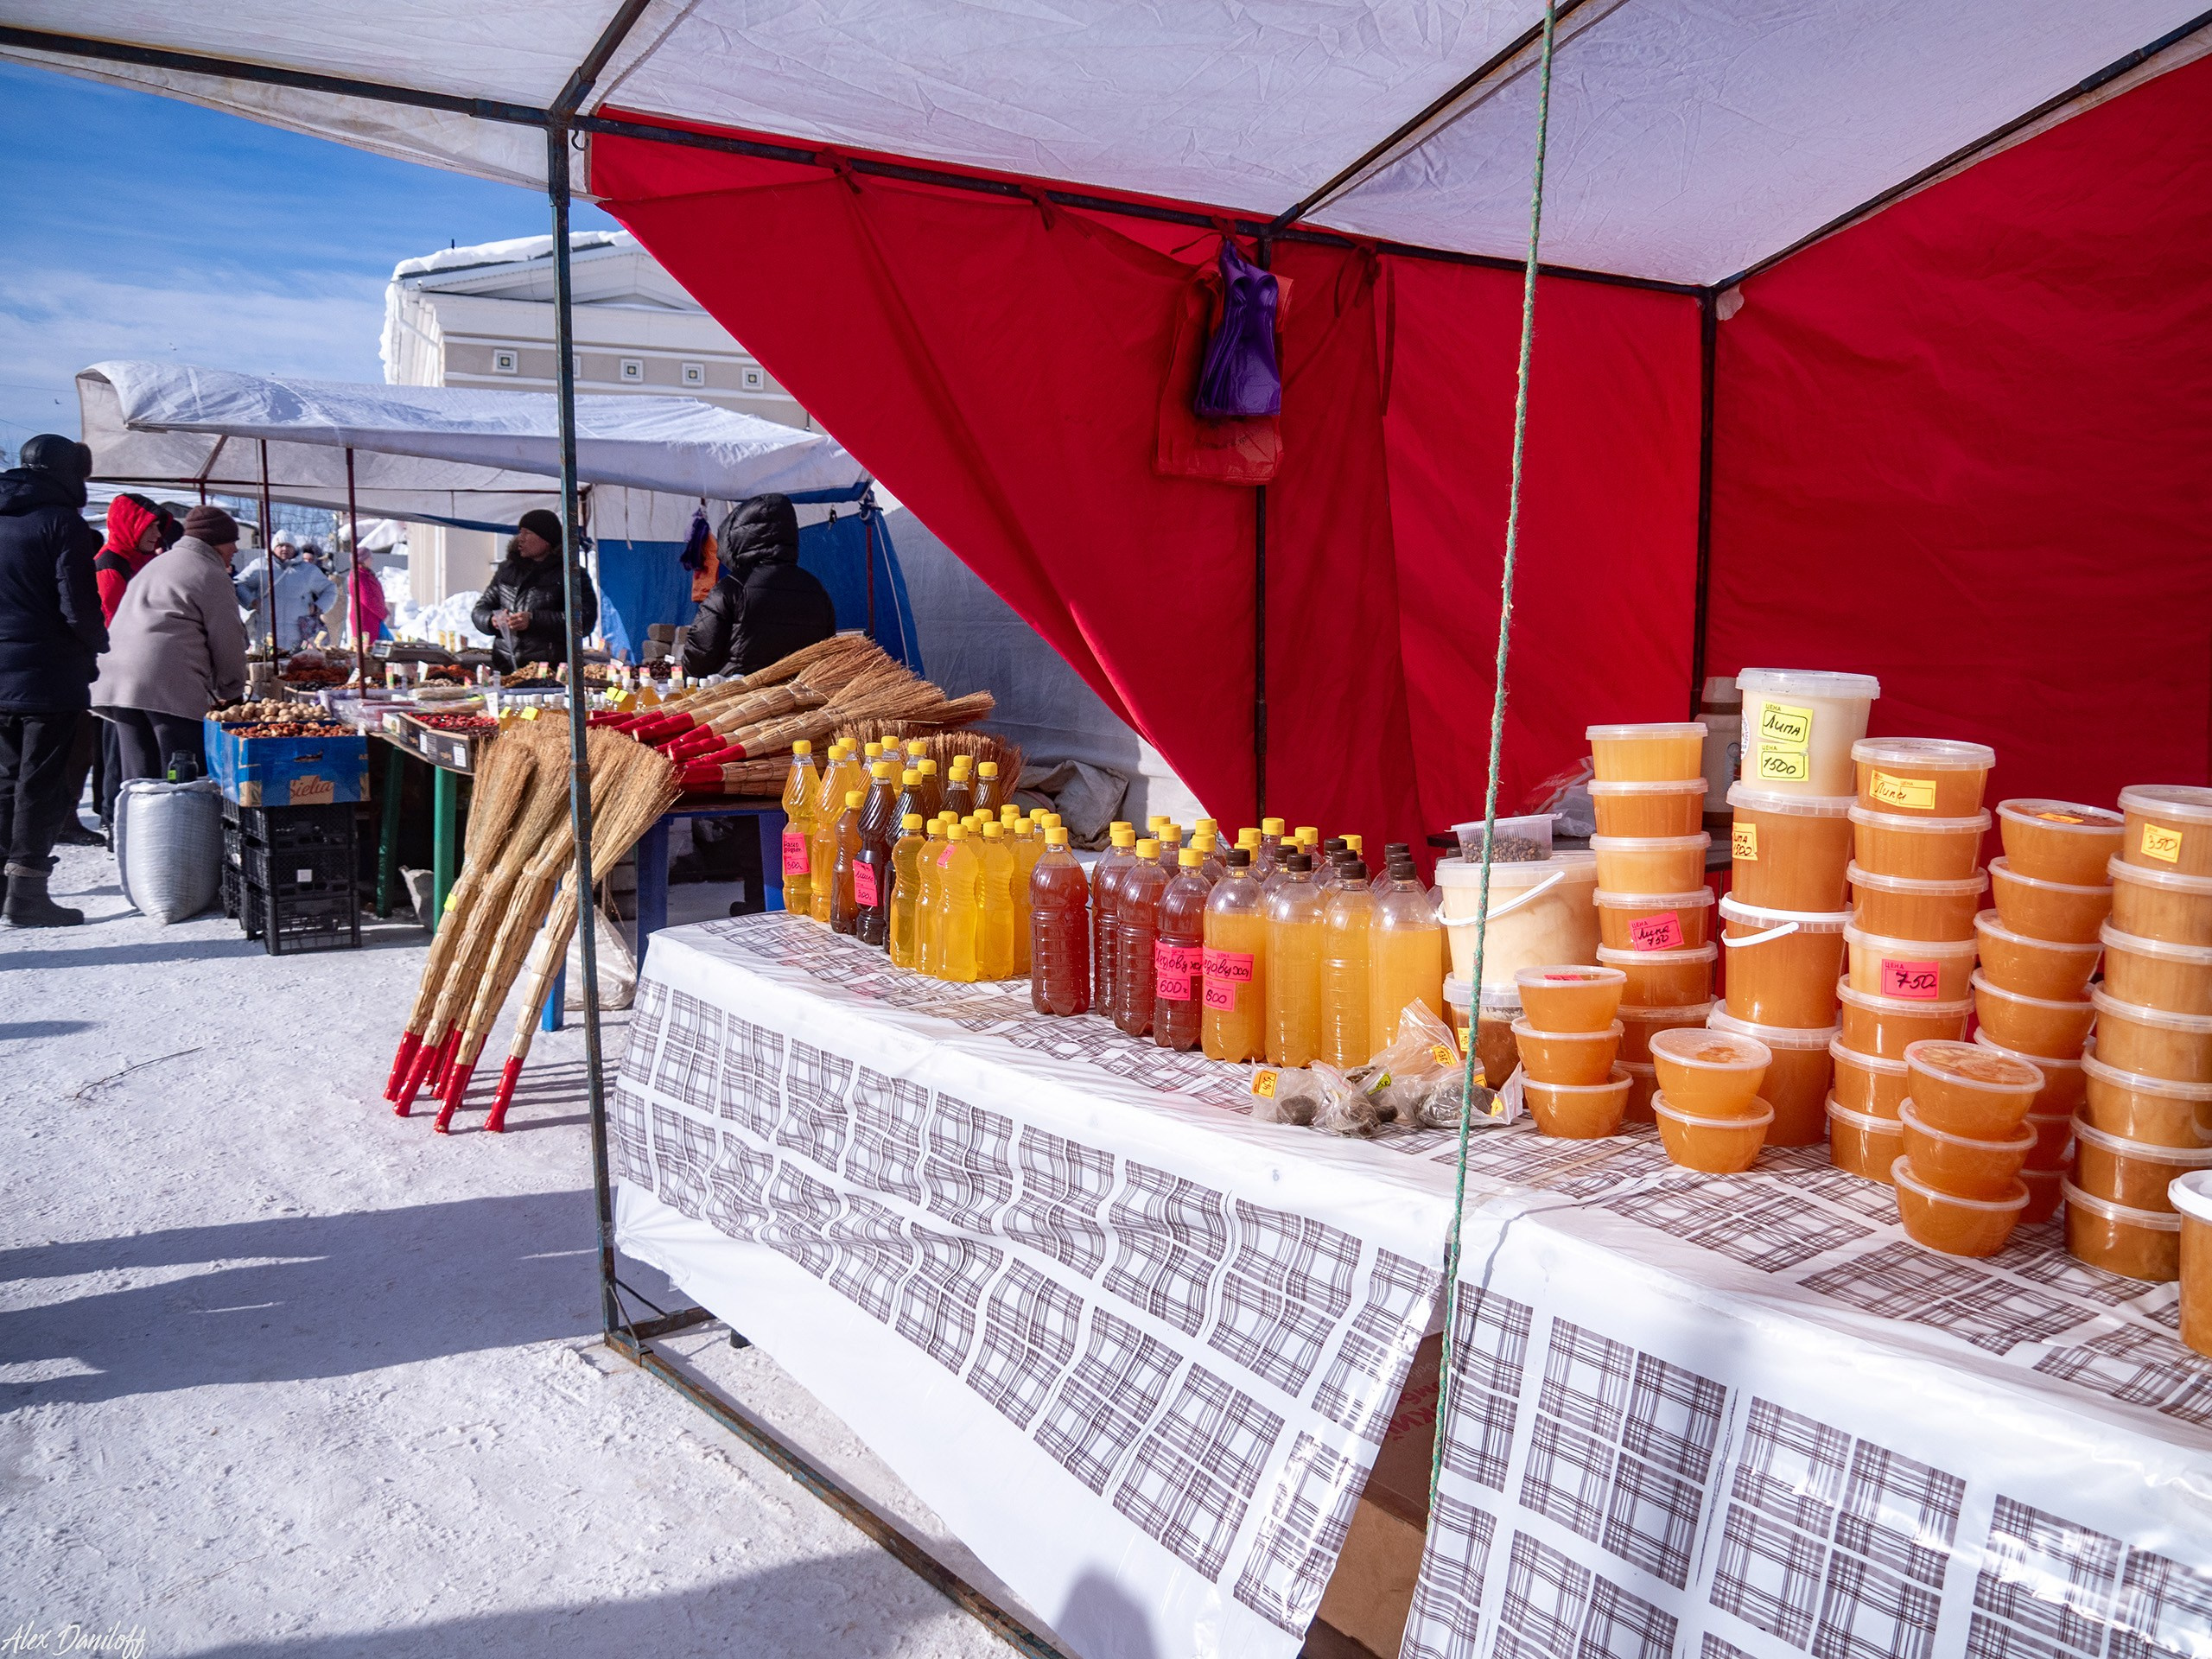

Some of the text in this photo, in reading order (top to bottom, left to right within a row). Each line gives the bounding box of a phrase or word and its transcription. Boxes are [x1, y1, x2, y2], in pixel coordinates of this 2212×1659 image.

[1765, 703, 1782, 712] ЦЕНА
[1764, 757, 1796, 774] 1500
[2148, 835, 2177, 851] 350
[1647, 934, 1669, 947] 750
[1885, 961, 1904, 969] ЦЕНА
[1896, 970, 1936, 989] 750
